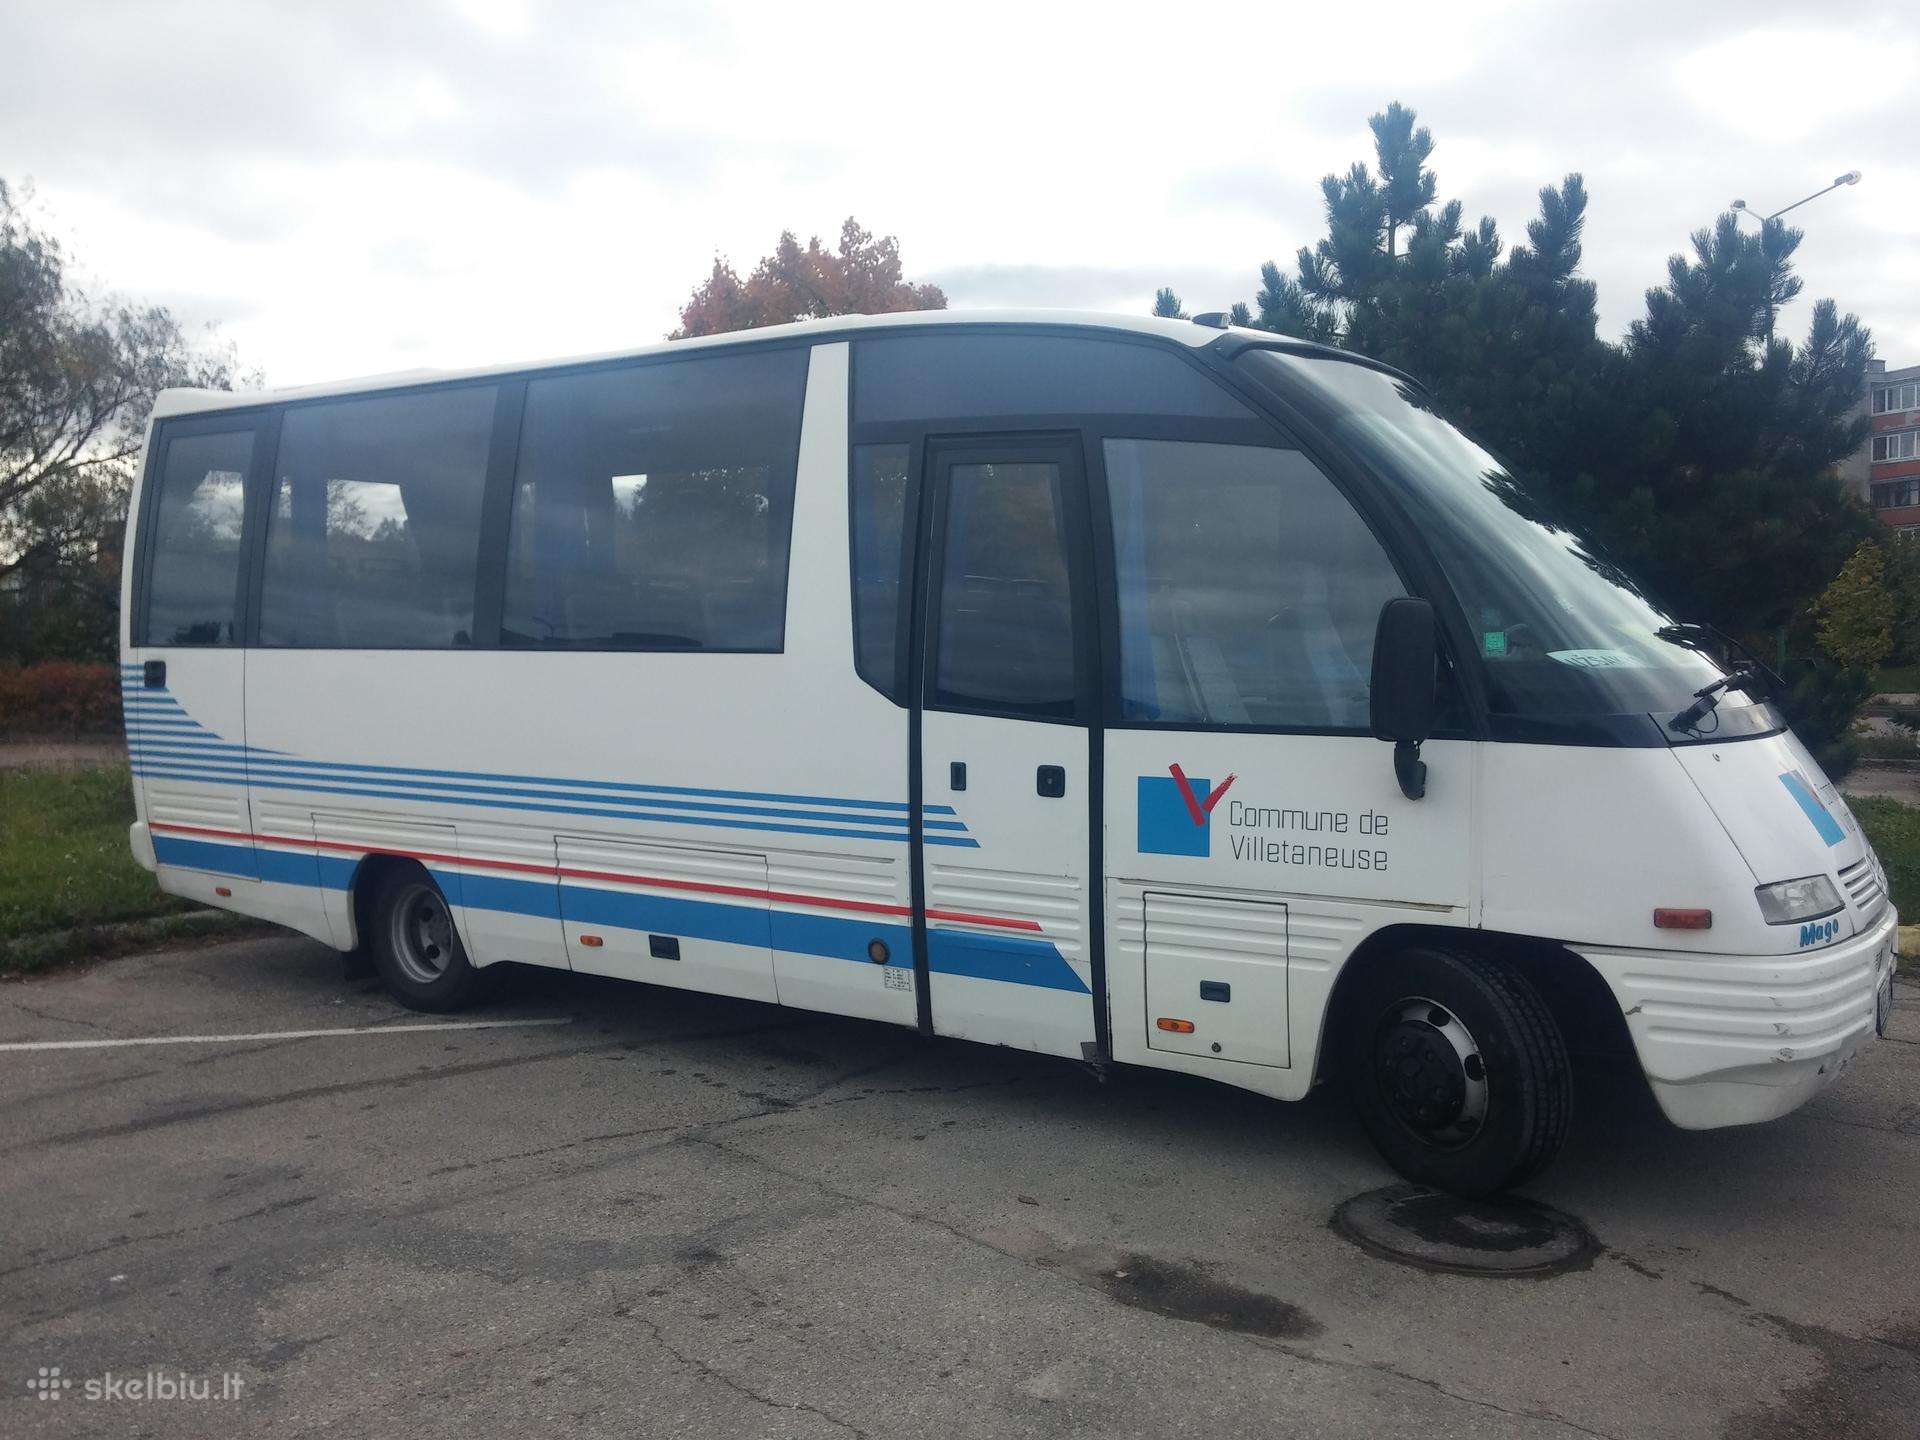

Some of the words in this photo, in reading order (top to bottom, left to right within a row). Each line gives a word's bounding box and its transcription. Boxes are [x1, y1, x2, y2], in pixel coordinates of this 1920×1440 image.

[1230, 800, 1348, 833] Commune
[1359, 809, 1388, 836] de
[1230, 834, 1388, 872] Villetaneuse
[1799, 918, 1840, 948] Mago
